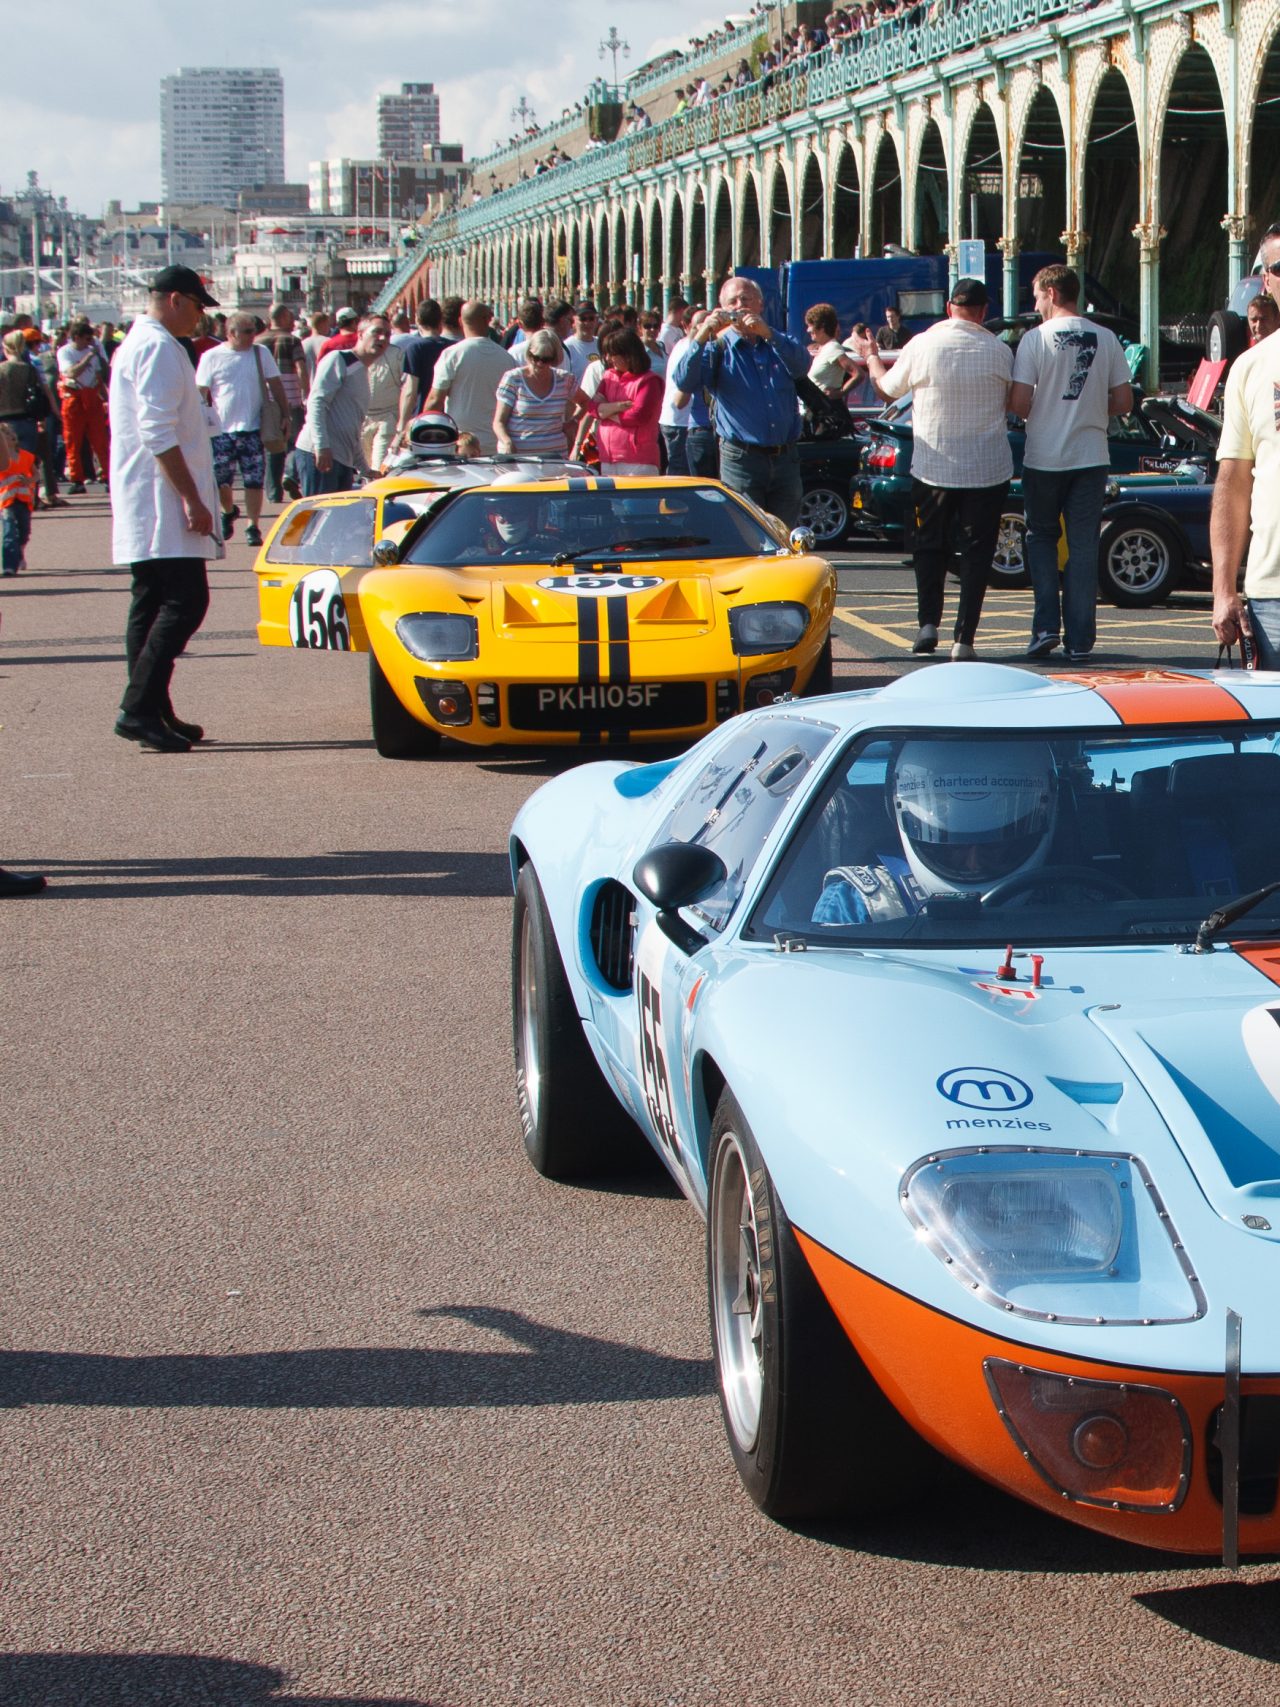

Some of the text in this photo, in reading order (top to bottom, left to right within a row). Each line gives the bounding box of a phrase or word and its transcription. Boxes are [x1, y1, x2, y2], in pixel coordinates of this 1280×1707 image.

[548, 575, 659, 589] 156
[293, 581, 350, 651] 156
[538, 683, 662, 711] PKH105F
[933, 775, 988, 788] chartered
[946, 1117, 1052, 1132] menzies
